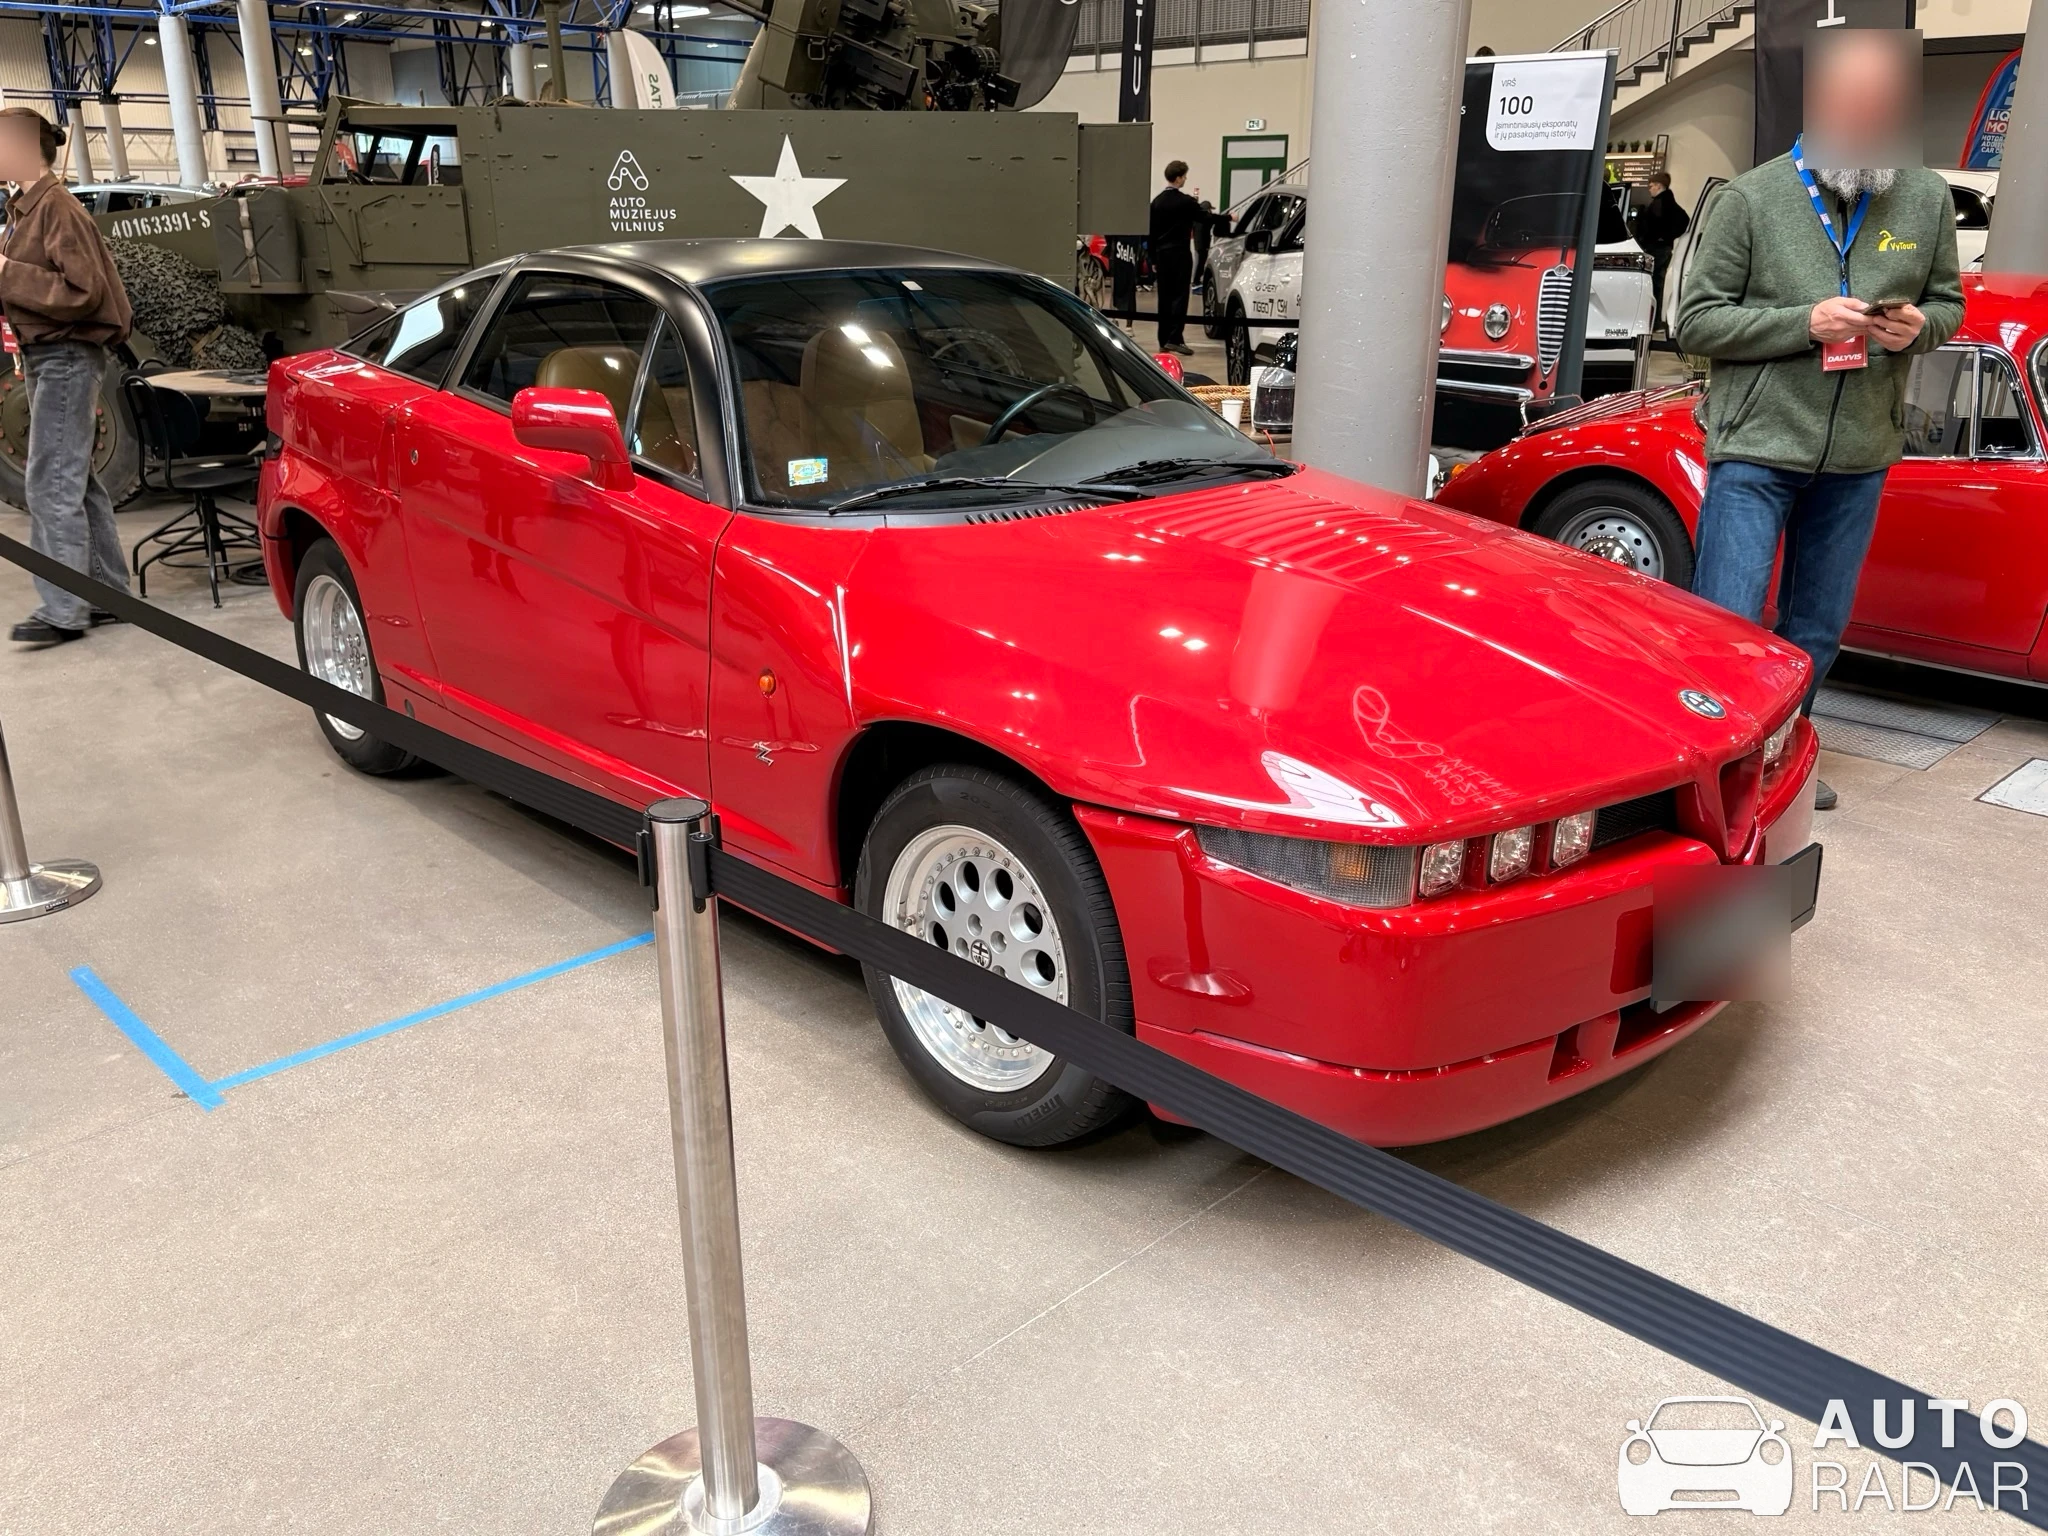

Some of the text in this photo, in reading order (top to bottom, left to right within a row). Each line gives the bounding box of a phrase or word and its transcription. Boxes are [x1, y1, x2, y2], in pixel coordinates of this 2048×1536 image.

[1501, 77, 1517, 87] VIRŠ
[1500, 95, 1533, 115] 100
[1541, 120, 1578, 129] eksponatų
[1508, 131, 1549, 139] pasakojamų
[1550, 130, 1577, 138] istorijų
[610, 197, 646, 208] AUTO
[610, 209, 677, 220] MUZIEJUS
[112, 209, 211, 239] 40163391-S
[611, 222, 665, 232] VILNIUS
[1890, 241, 1917, 251] VyTours
[1827, 353, 1862, 362] DALYVIS
